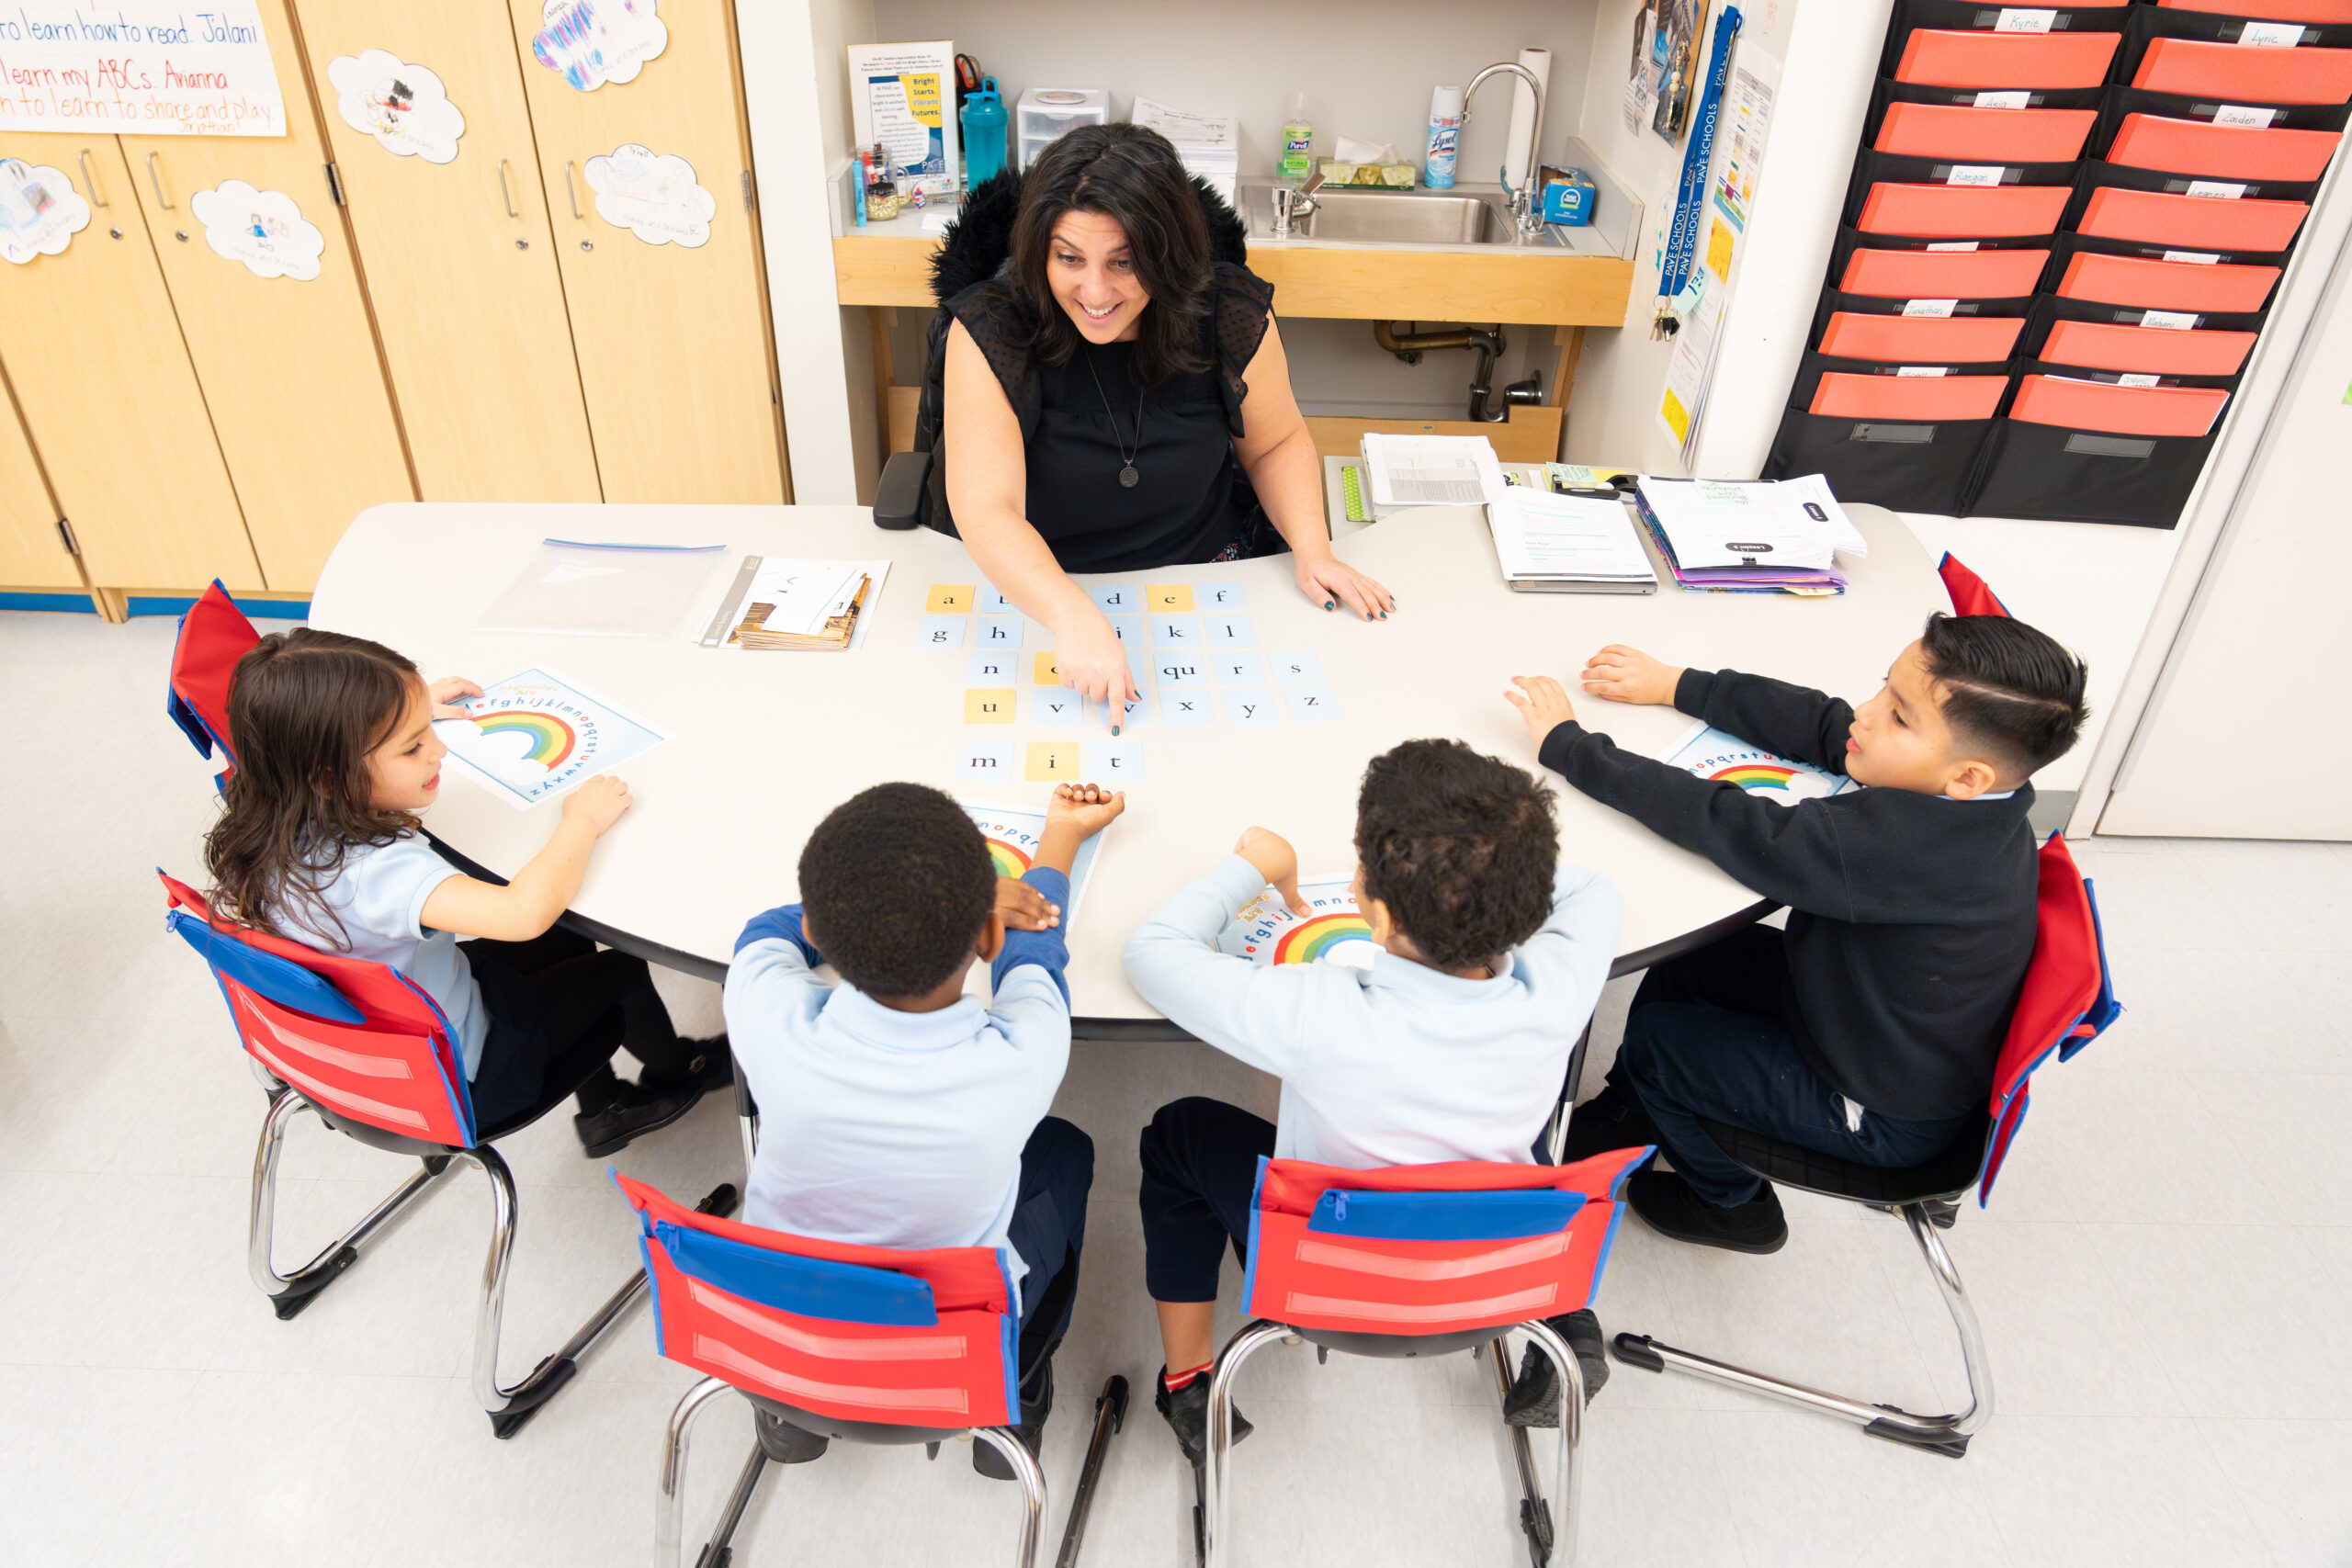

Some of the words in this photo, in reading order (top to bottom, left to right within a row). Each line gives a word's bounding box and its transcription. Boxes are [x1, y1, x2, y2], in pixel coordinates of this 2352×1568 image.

[19, 7, 77, 40] learn
[75, 9, 118, 42] how
[119, 11, 141, 42] to
[146, 14, 192, 44] read.
[195, 13, 257, 43] Jalani
[2009, 15, 2040, 29] Kyrie
[2251, 28, 2278, 46] Lyric
[0, 58, 57, 88] learn
[62, 69, 92, 98] my
[165, 59, 228, 89] Arianna
[18, 87, 44, 117] to
[50, 87, 109, 118] learn
[112, 87, 137, 119] to
[143, 94, 193, 120] share
[197, 96, 229, 119] and
[1702, 103, 1717, 155] SCHOOLS
[2222, 112, 2256, 125] Zaiden
[1431, 131, 1457, 149] Lysol
[1696, 157, 1709, 184] PAVE
[1670, 202, 1688, 251] SCHOOLS
[1679, 251, 1691, 276] PAVE
[1685, 200, 1702, 249] SCHOOLS
[1665, 253, 1678, 276] PAVE
[943, 596, 956, 604] a
[1106, 592, 1121, 604] d
[1164, 596, 1176, 604] e
[1216, 590, 1227, 603] f
[932, 630, 947, 643] g
[991, 626, 1007, 639] h
[1168, 625, 1183, 637] k
[983, 665, 1000, 674] n
[1163, 667, 1196, 680] qu
[1233, 666, 1243, 675] r
[1291, 665, 1301, 673] s
[982, 704, 998, 713] u
[1049, 704, 1065, 714] v
[1179, 702, 1194, 711] x
[1242, 705, 1257, 718] y
[1304, 696, 1319, 706] z
[970, 758, 998, 769] m
[1049, 755, 1056, 769] i
[1110, 757, 1122, 769] t
